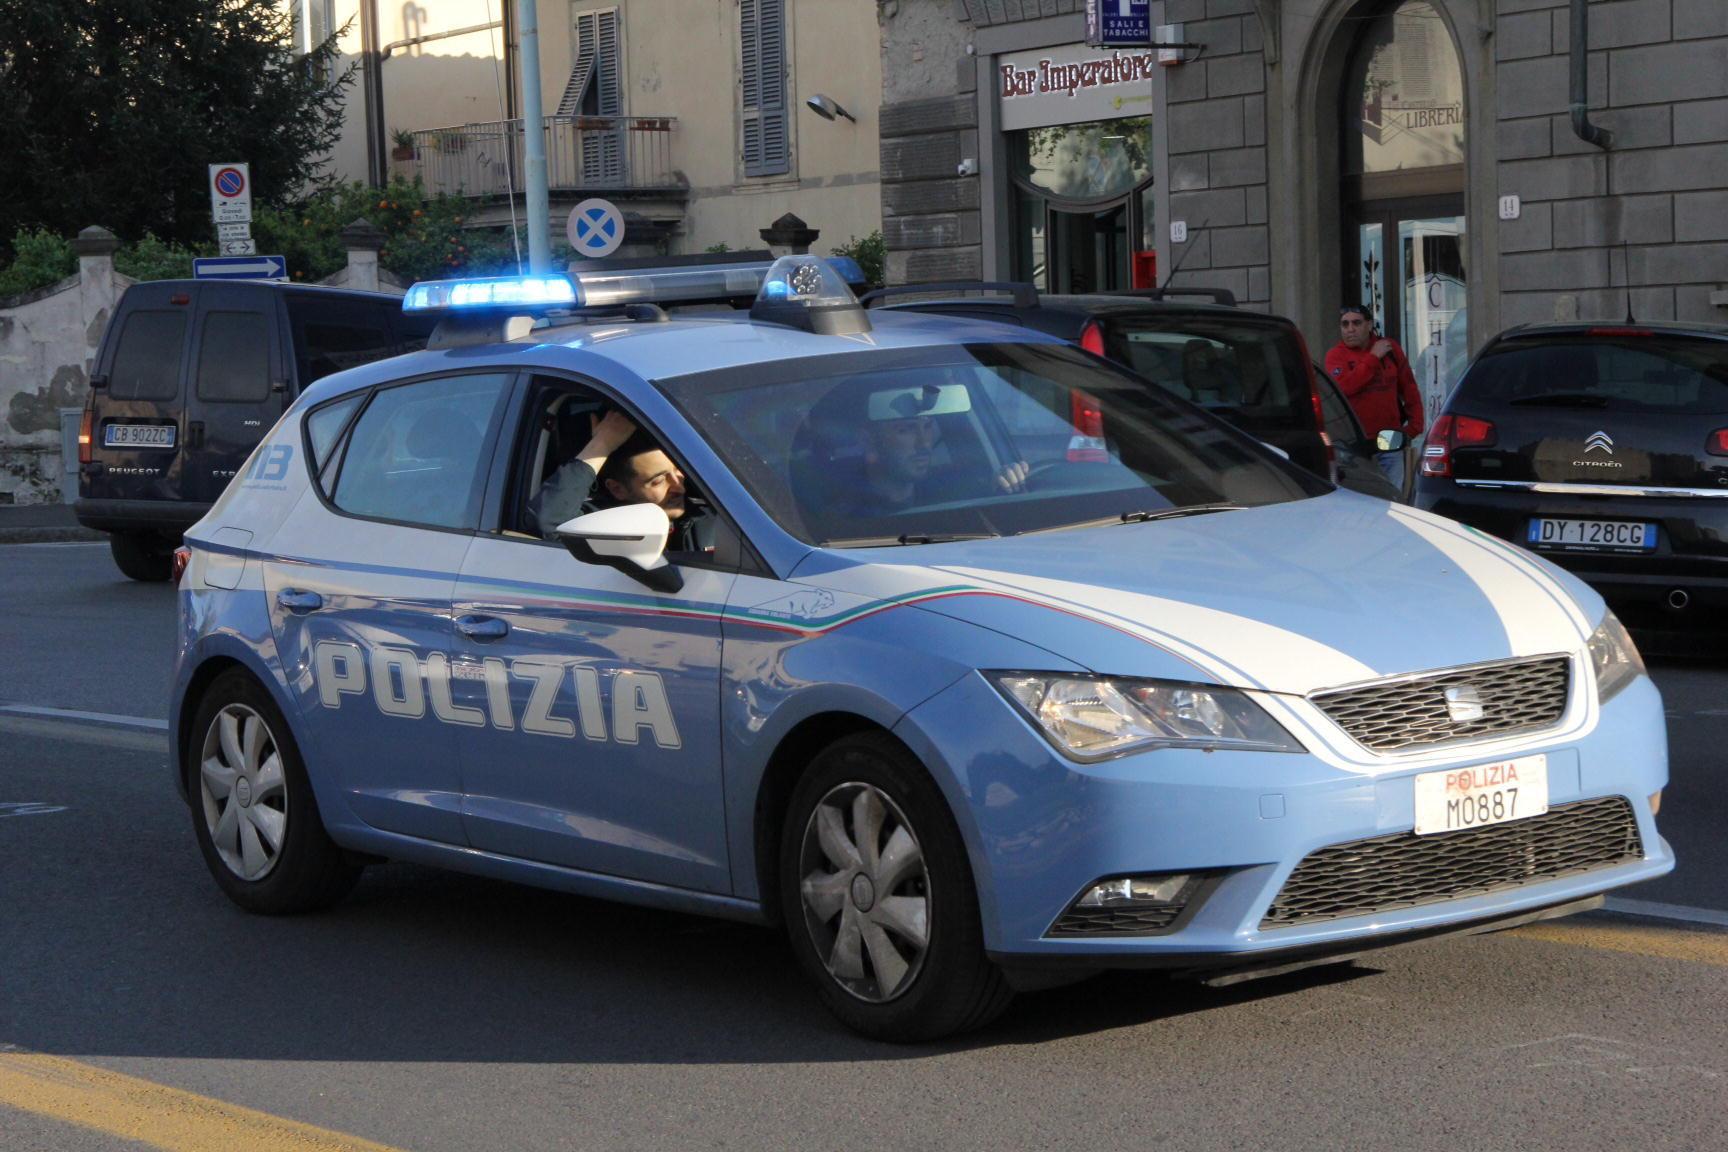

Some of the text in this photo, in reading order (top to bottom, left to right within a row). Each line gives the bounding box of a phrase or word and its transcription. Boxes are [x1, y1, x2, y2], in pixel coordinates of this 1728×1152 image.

[1087, 0, 1096, 37] CHI
[1109, 20, 1145, 28] SALI E
[1103, 28, 1149, 36] TABACCHI
[1000, 64, 1037, 98] Bar
[1504, 198, 1514, 211] 14
[1174, 223, 1183, 236] 16
[114, 427, 167, 443] CB 902ZC
[108, 467, 161, 475] PEUGEOT
[1542, 521, 1643, 544] DY 128CG
[315, 639, 682, 749] POLIZIA
[1446, 763, 1518, 792] POLIZIA
[1447, 788, 1518, 829] M0887
